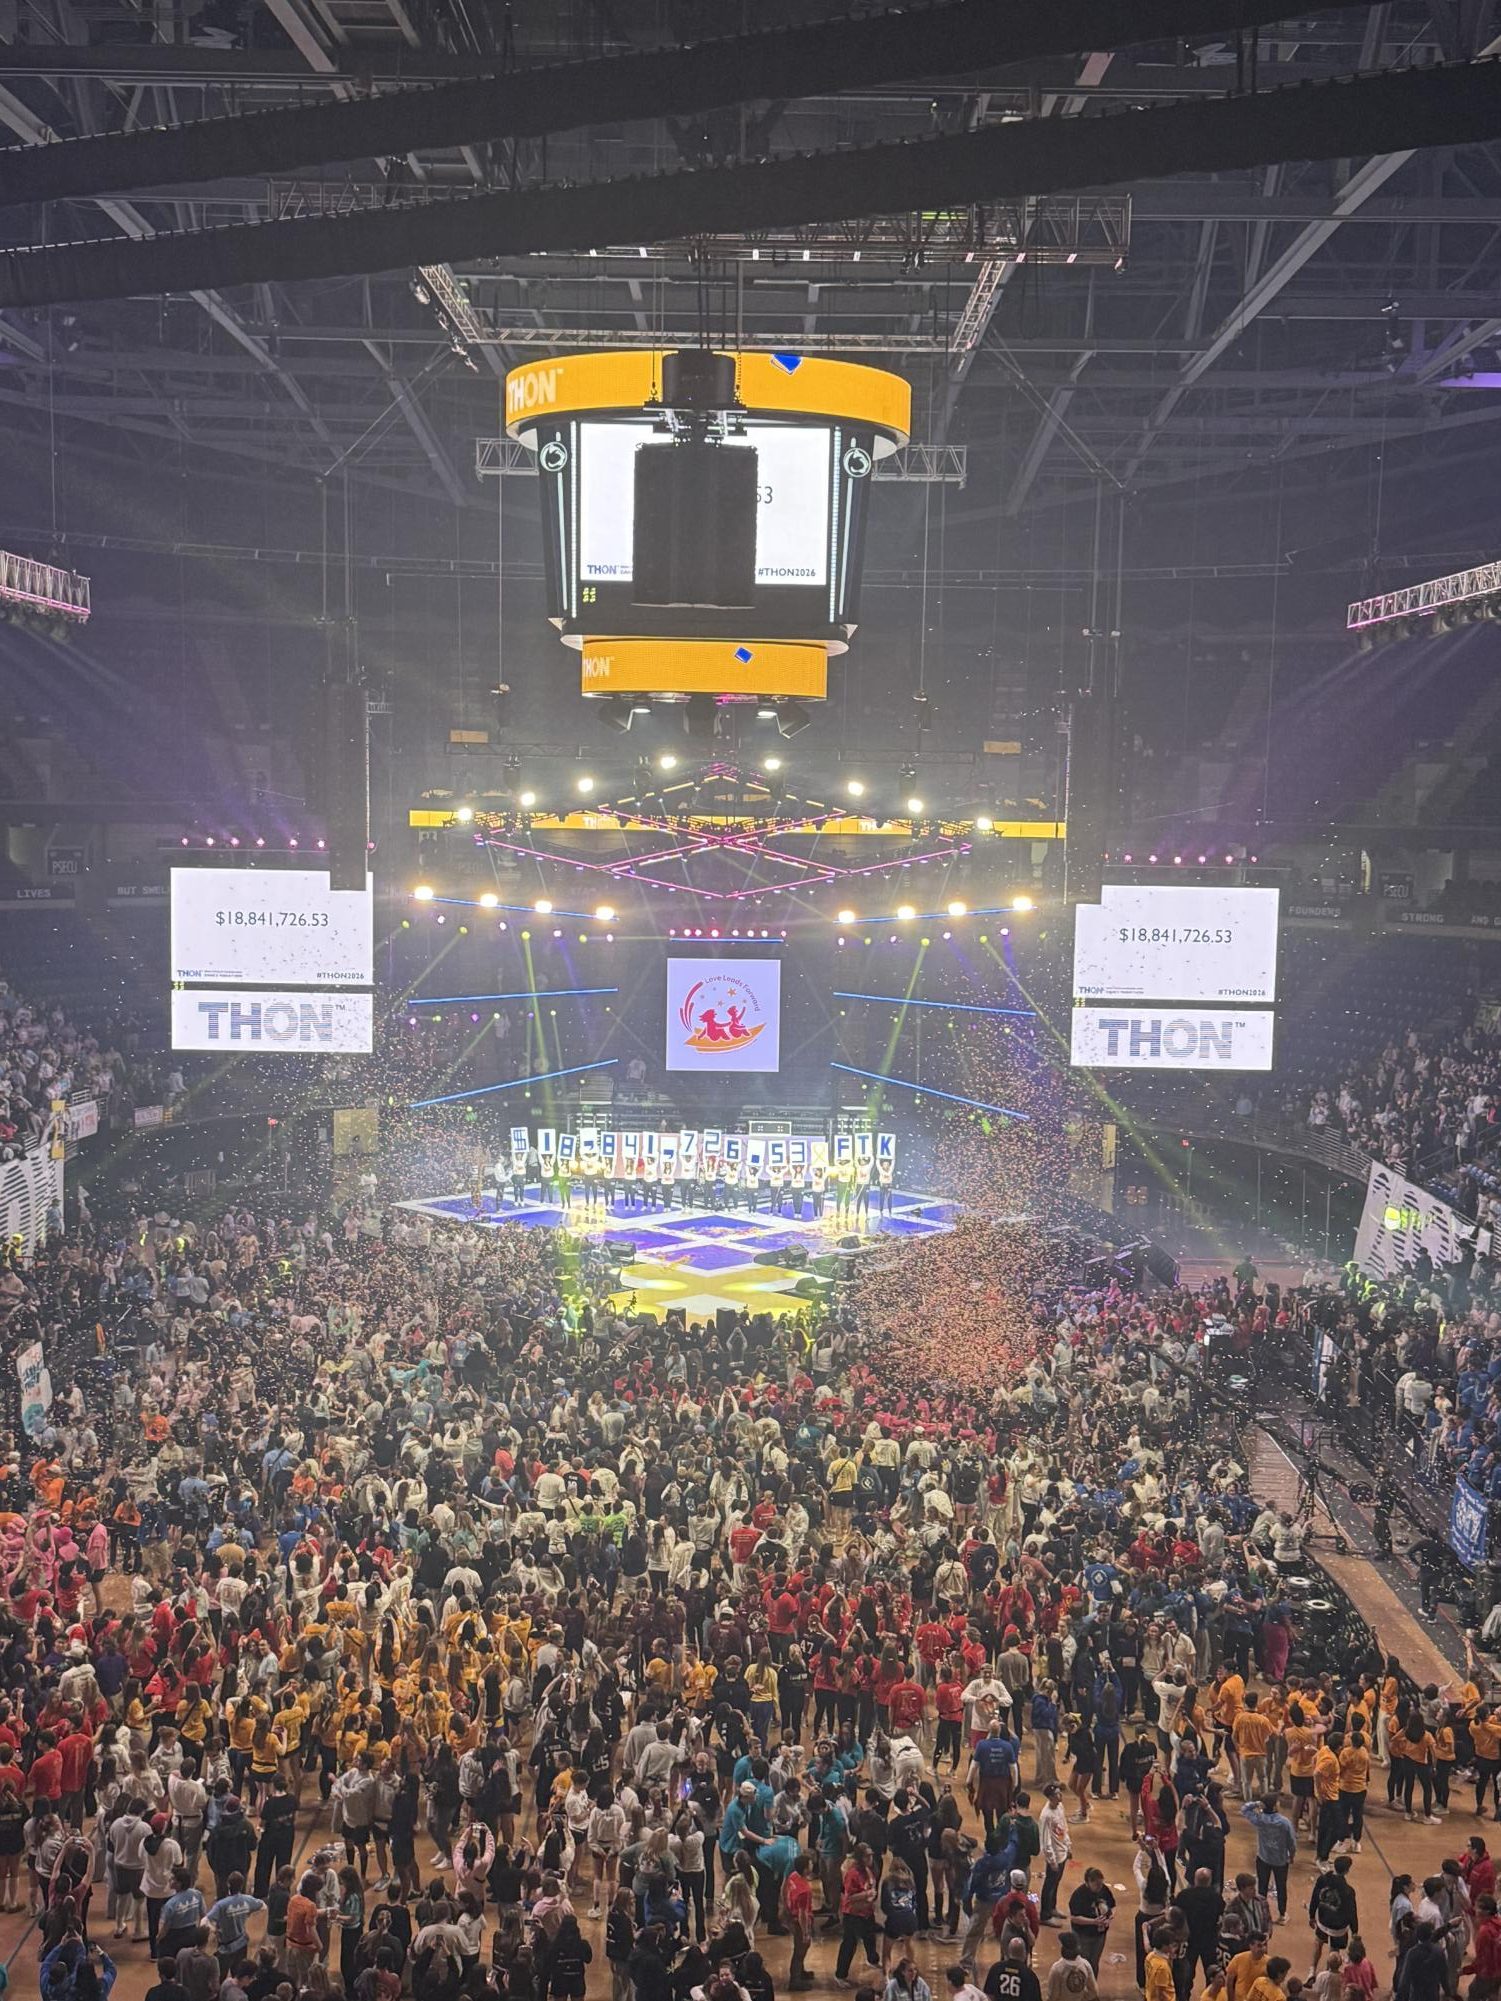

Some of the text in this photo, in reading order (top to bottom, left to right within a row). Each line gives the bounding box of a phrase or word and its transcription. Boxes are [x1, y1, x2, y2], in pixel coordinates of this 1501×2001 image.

[758, 568, 816, 576] #THON2026
[17, 889, 51, 898] LIVES
[215, 911, 329, 927] $18,841,726.53
[1402, 913, 1444, 923] STRONG
[1119, 928, 1232, 943] $18,841,726.53
[1000, 1973, 1021, 1996] 26
